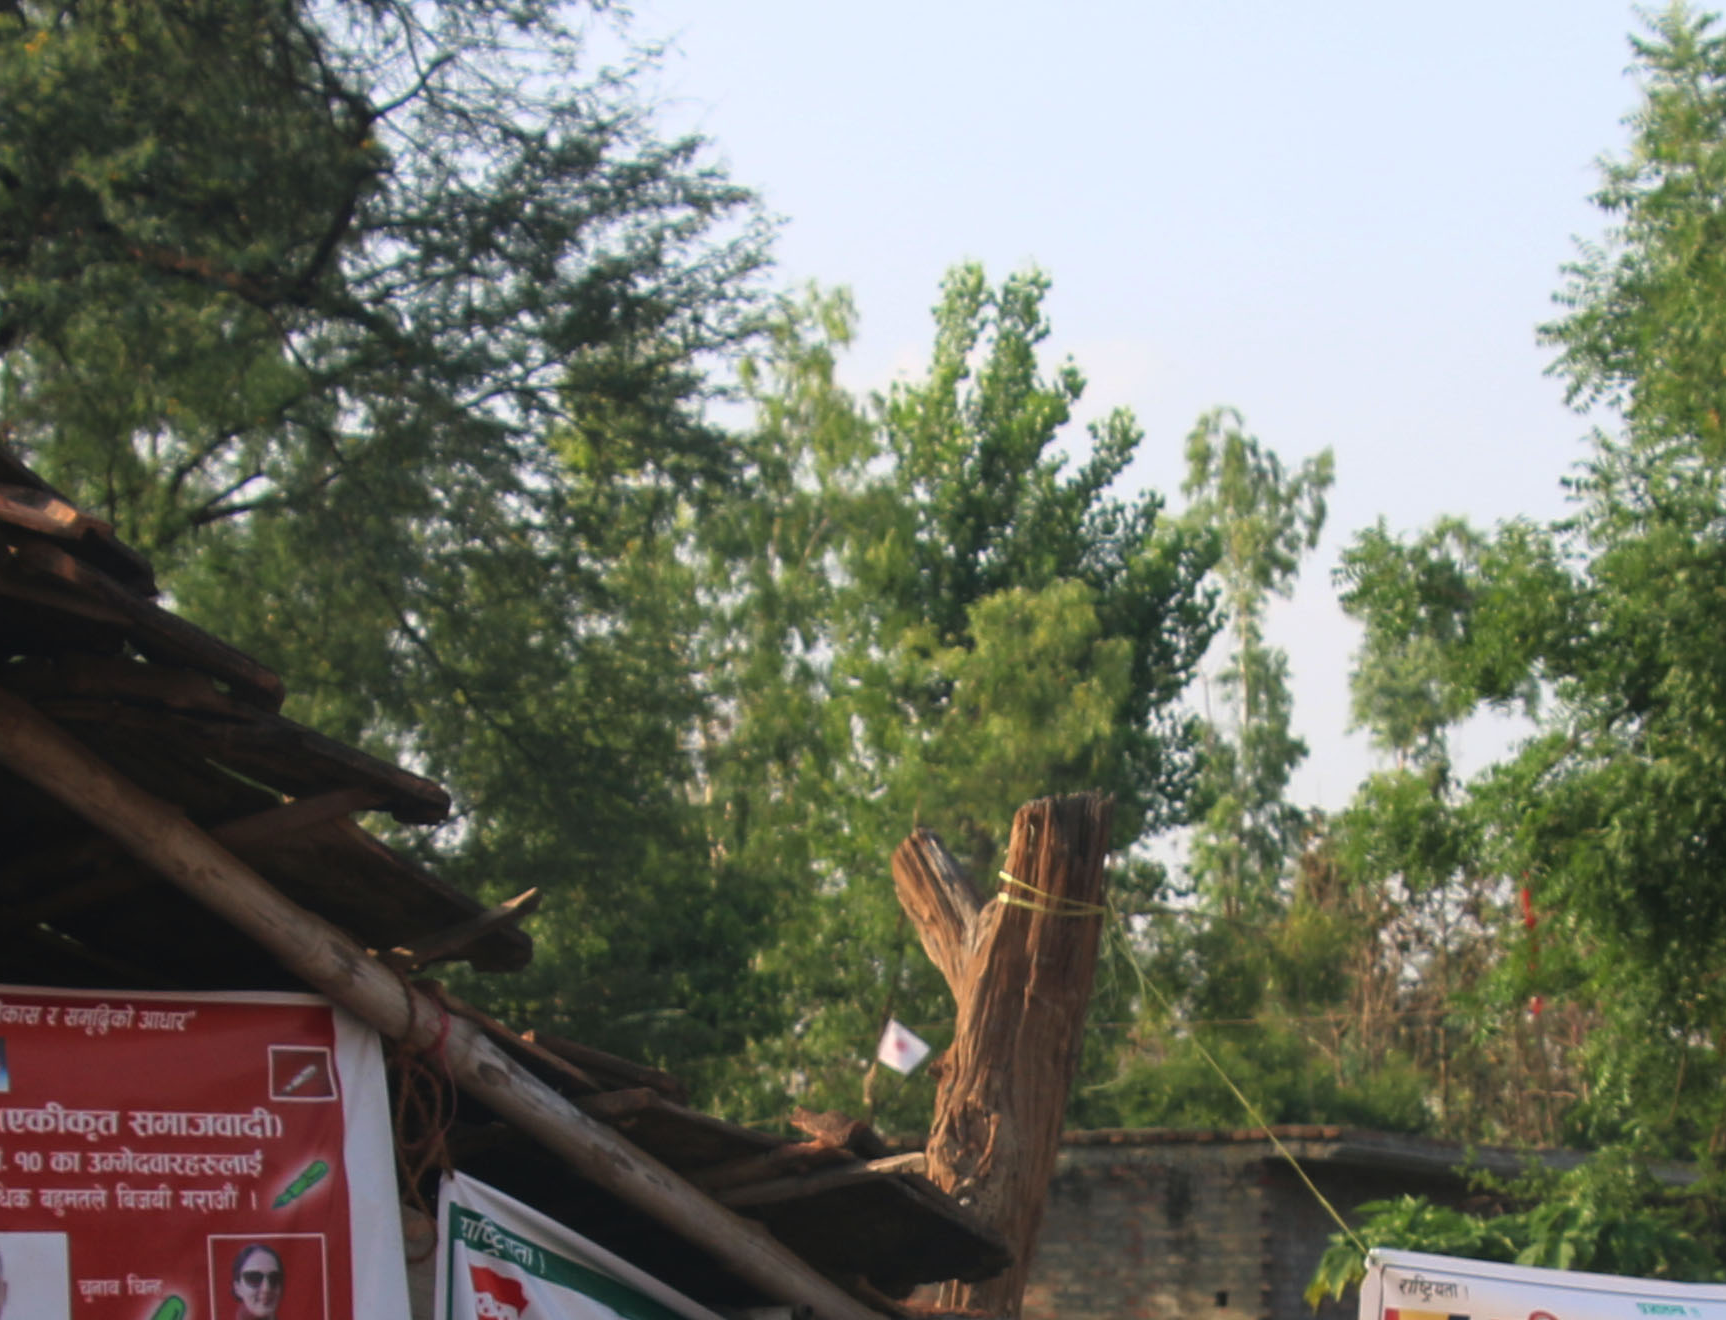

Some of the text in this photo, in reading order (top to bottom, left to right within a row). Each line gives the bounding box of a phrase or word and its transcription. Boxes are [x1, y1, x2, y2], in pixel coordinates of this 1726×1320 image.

[46, 1006, 56, 1025] र
[128, 1107, 283, 1138] समाजवादी)
[15, 1152, 42, 1172] १०
[50, 1152, 80, 1174] का
[39, 1185, 107, 1216] बहुमतले
[79, 1279, 121, 1303] चुनाव
